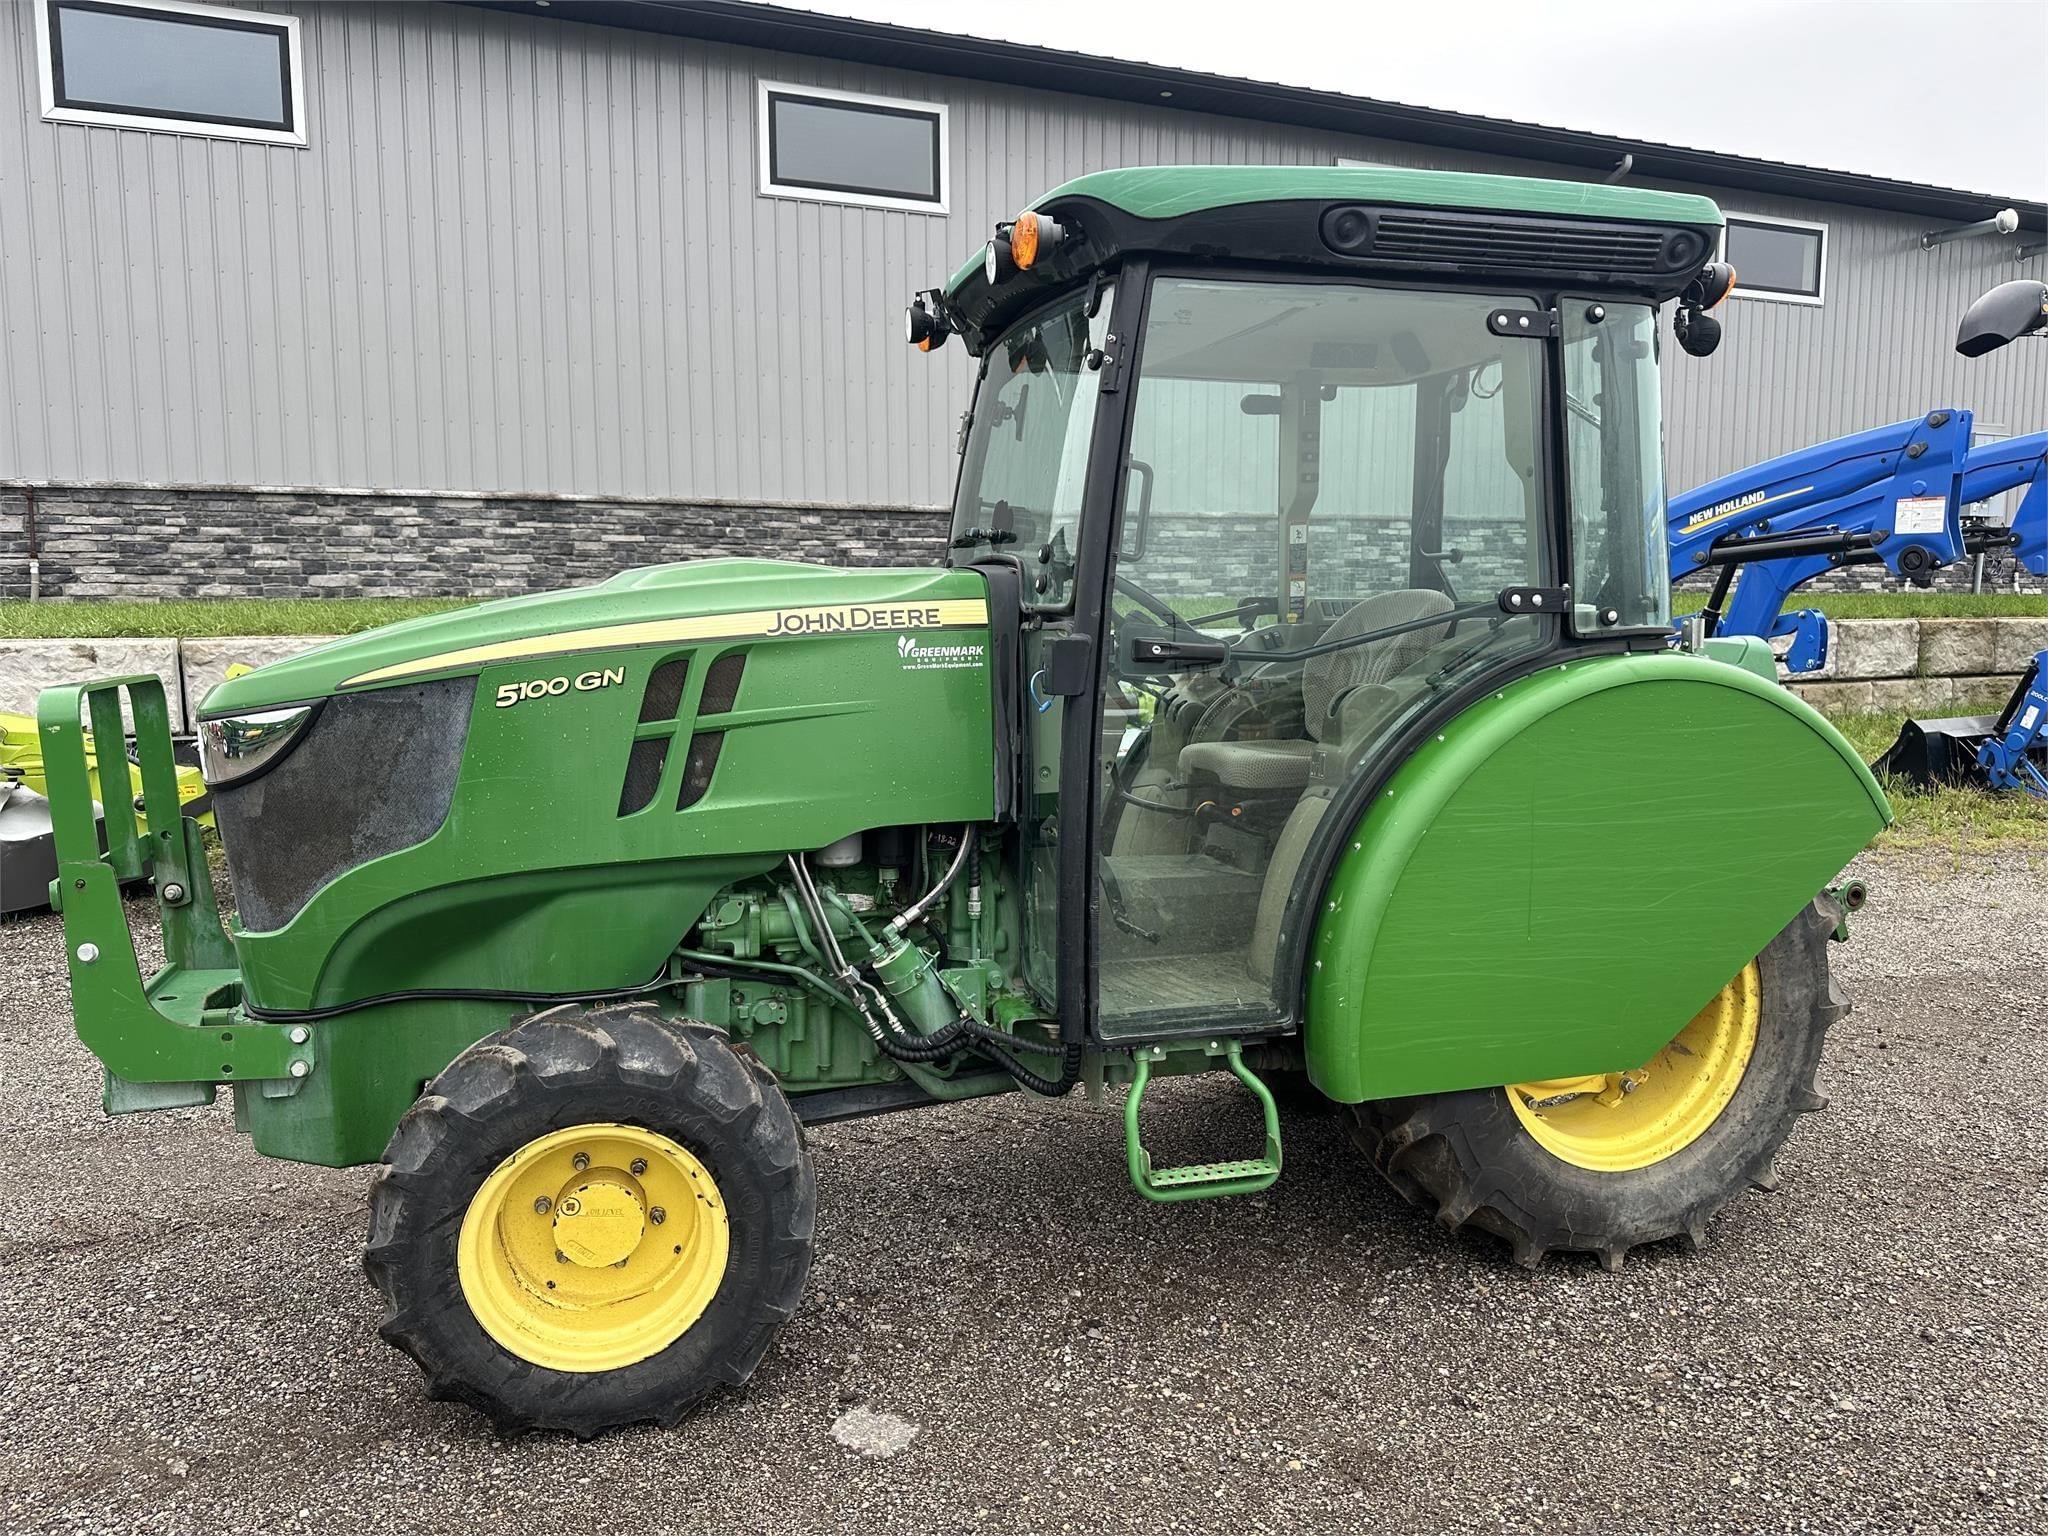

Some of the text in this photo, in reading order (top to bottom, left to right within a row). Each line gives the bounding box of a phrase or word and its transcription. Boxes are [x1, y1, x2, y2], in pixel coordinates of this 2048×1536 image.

[1689, 490, 1766, 526] NEW HOLLAND
[767, 607, 942, 634] JOHN DEERE
[911, 645, 984, 658] GREENMARK
[495, 666, 626, 708] 5100 GN
